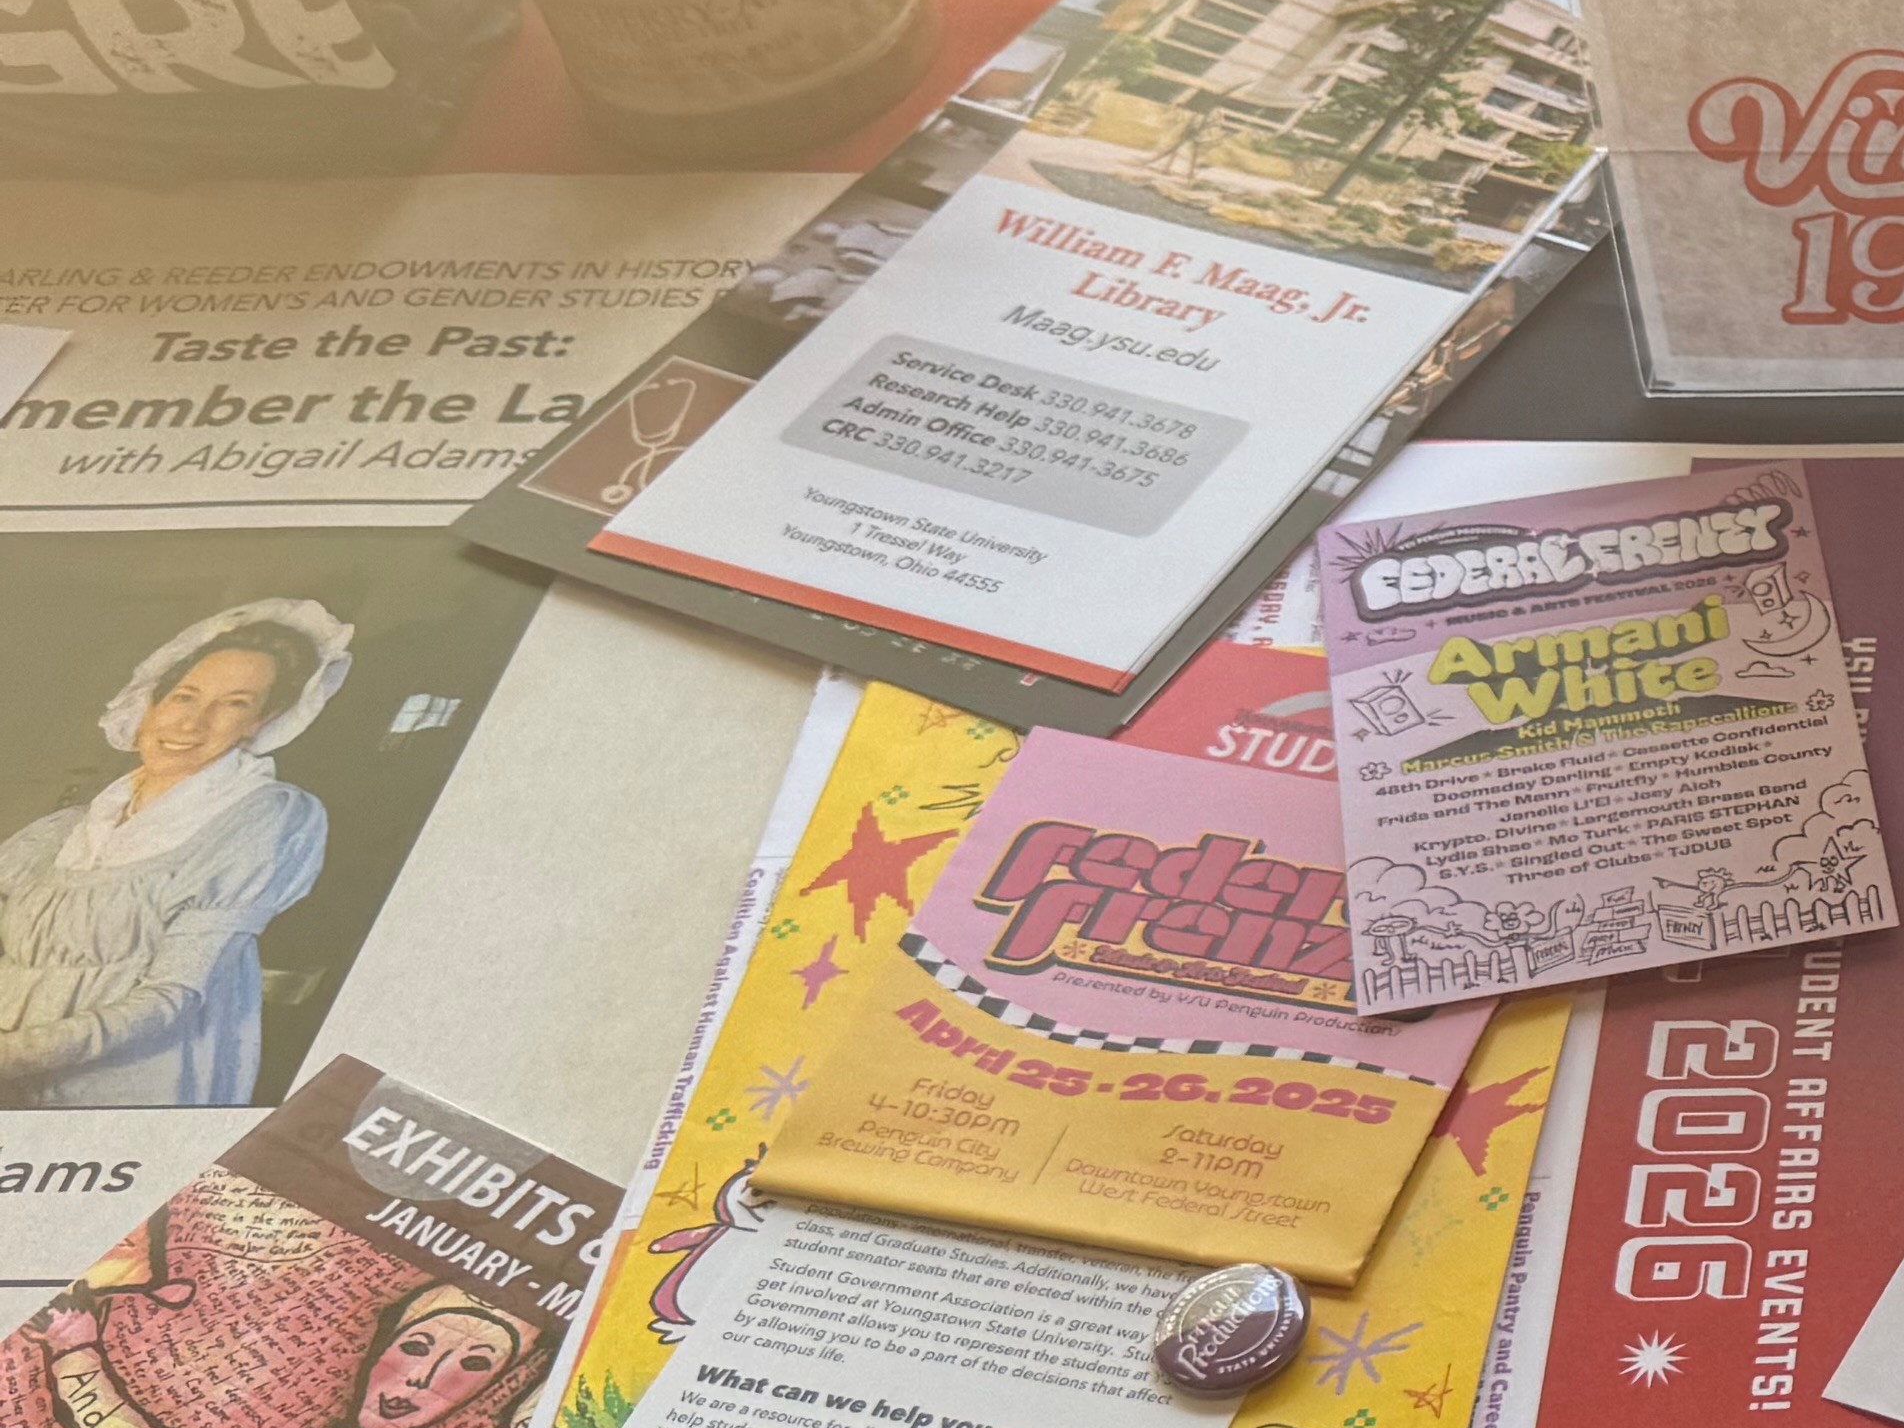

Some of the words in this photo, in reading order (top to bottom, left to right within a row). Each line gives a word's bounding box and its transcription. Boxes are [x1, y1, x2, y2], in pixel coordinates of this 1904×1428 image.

[997, 209, 1145, 270] William
[1151, 251, 1188, 280] F.
[1204, 262, 1311, 315] Maag,
[1311, 292, 1368, 323] Jr.
[1070, 270, 1215, 334] Library
[152, 331, 298, 362] Taste
[315, 324, 411, 357] the
[426, 326, 574, 357] Past:
[1002, 304, 1221, 372] Maag.ysu.edu
[867, 372, 972, 411] Research
[974, 402, 1031, 429] Help
[1033, 416, 1188, 466] 330.941.3686
[890, 351, 975, 383] Service
[977, 373, 1039, 400] Desk
[1039, 390, 1197, 439] 330.941.3678
[58, 443, 163, 474] with
[168, 438, 364, 478] Abigail
[821, 418, 875, 444] CRC
[874, 429, 1033, 484] 330.941.3217
[1359, 536, 1587, 611] FEDERAL
[1580, 504, 1781, 573] FRENZY
[1427, 594, 1732, 684] Armani
[1467, 656, 1720, 725] White
[1518, 721, 1556, 741] Kid
[1562, 702, 1681, 733] Mammoth
[895, 998, 1016, 1076] April
[1227, 1076, 1396, 1124] 2025
[912, 1077, 995, 1110] Friday
[342, 1106, 595, 1245] EXHIBITS
[1162, 1124, 1284, 1159] Saturday
[1610, 1018, 1779, 1304] 2026
[1771, 1078, 1826, 1229] AFFAIRS
[366, 1200, 532, 1286] JANUARY
[1748, 1249, 1807, 1410] EVENTS!
[696, 1364, 769, 1394] What
[771, 1384, 819, 1404] can
[825, 1394, 866, 1413] we
